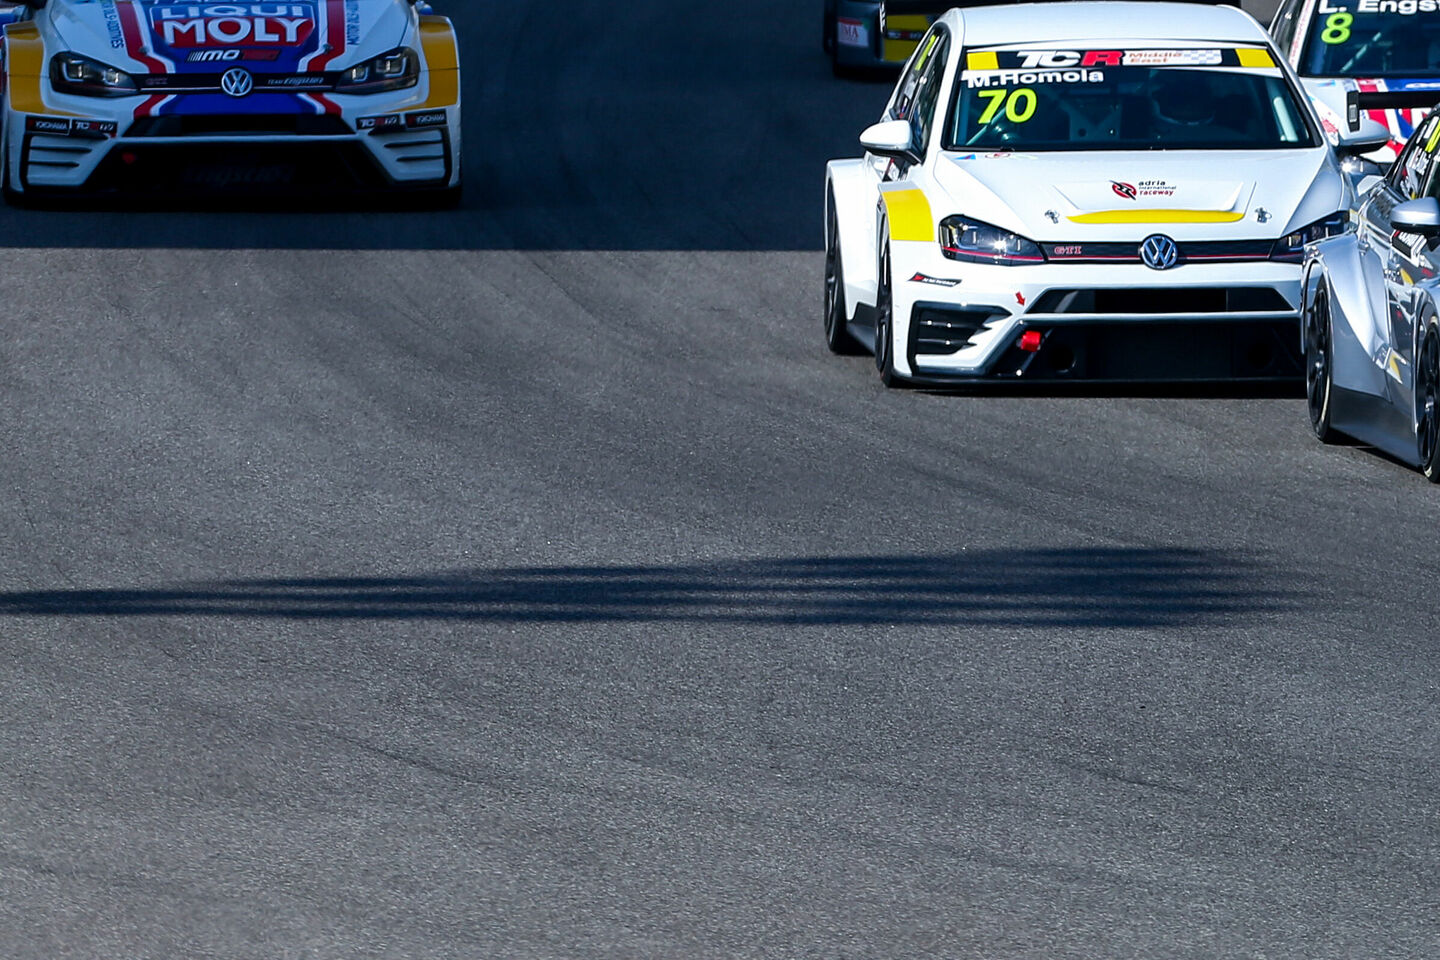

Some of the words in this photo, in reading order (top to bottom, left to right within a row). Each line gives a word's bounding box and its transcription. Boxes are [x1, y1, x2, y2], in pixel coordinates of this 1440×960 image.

[162, 6, 304, 19] LIQUI
[1318, 0, 1347, 14] L.
[162, 17, 309, 44] MOLY
[1321, 12, 1353, 44] 8
[1016, 51, 1123, 68] TCR
[977, 88, 1037, 124] 70
